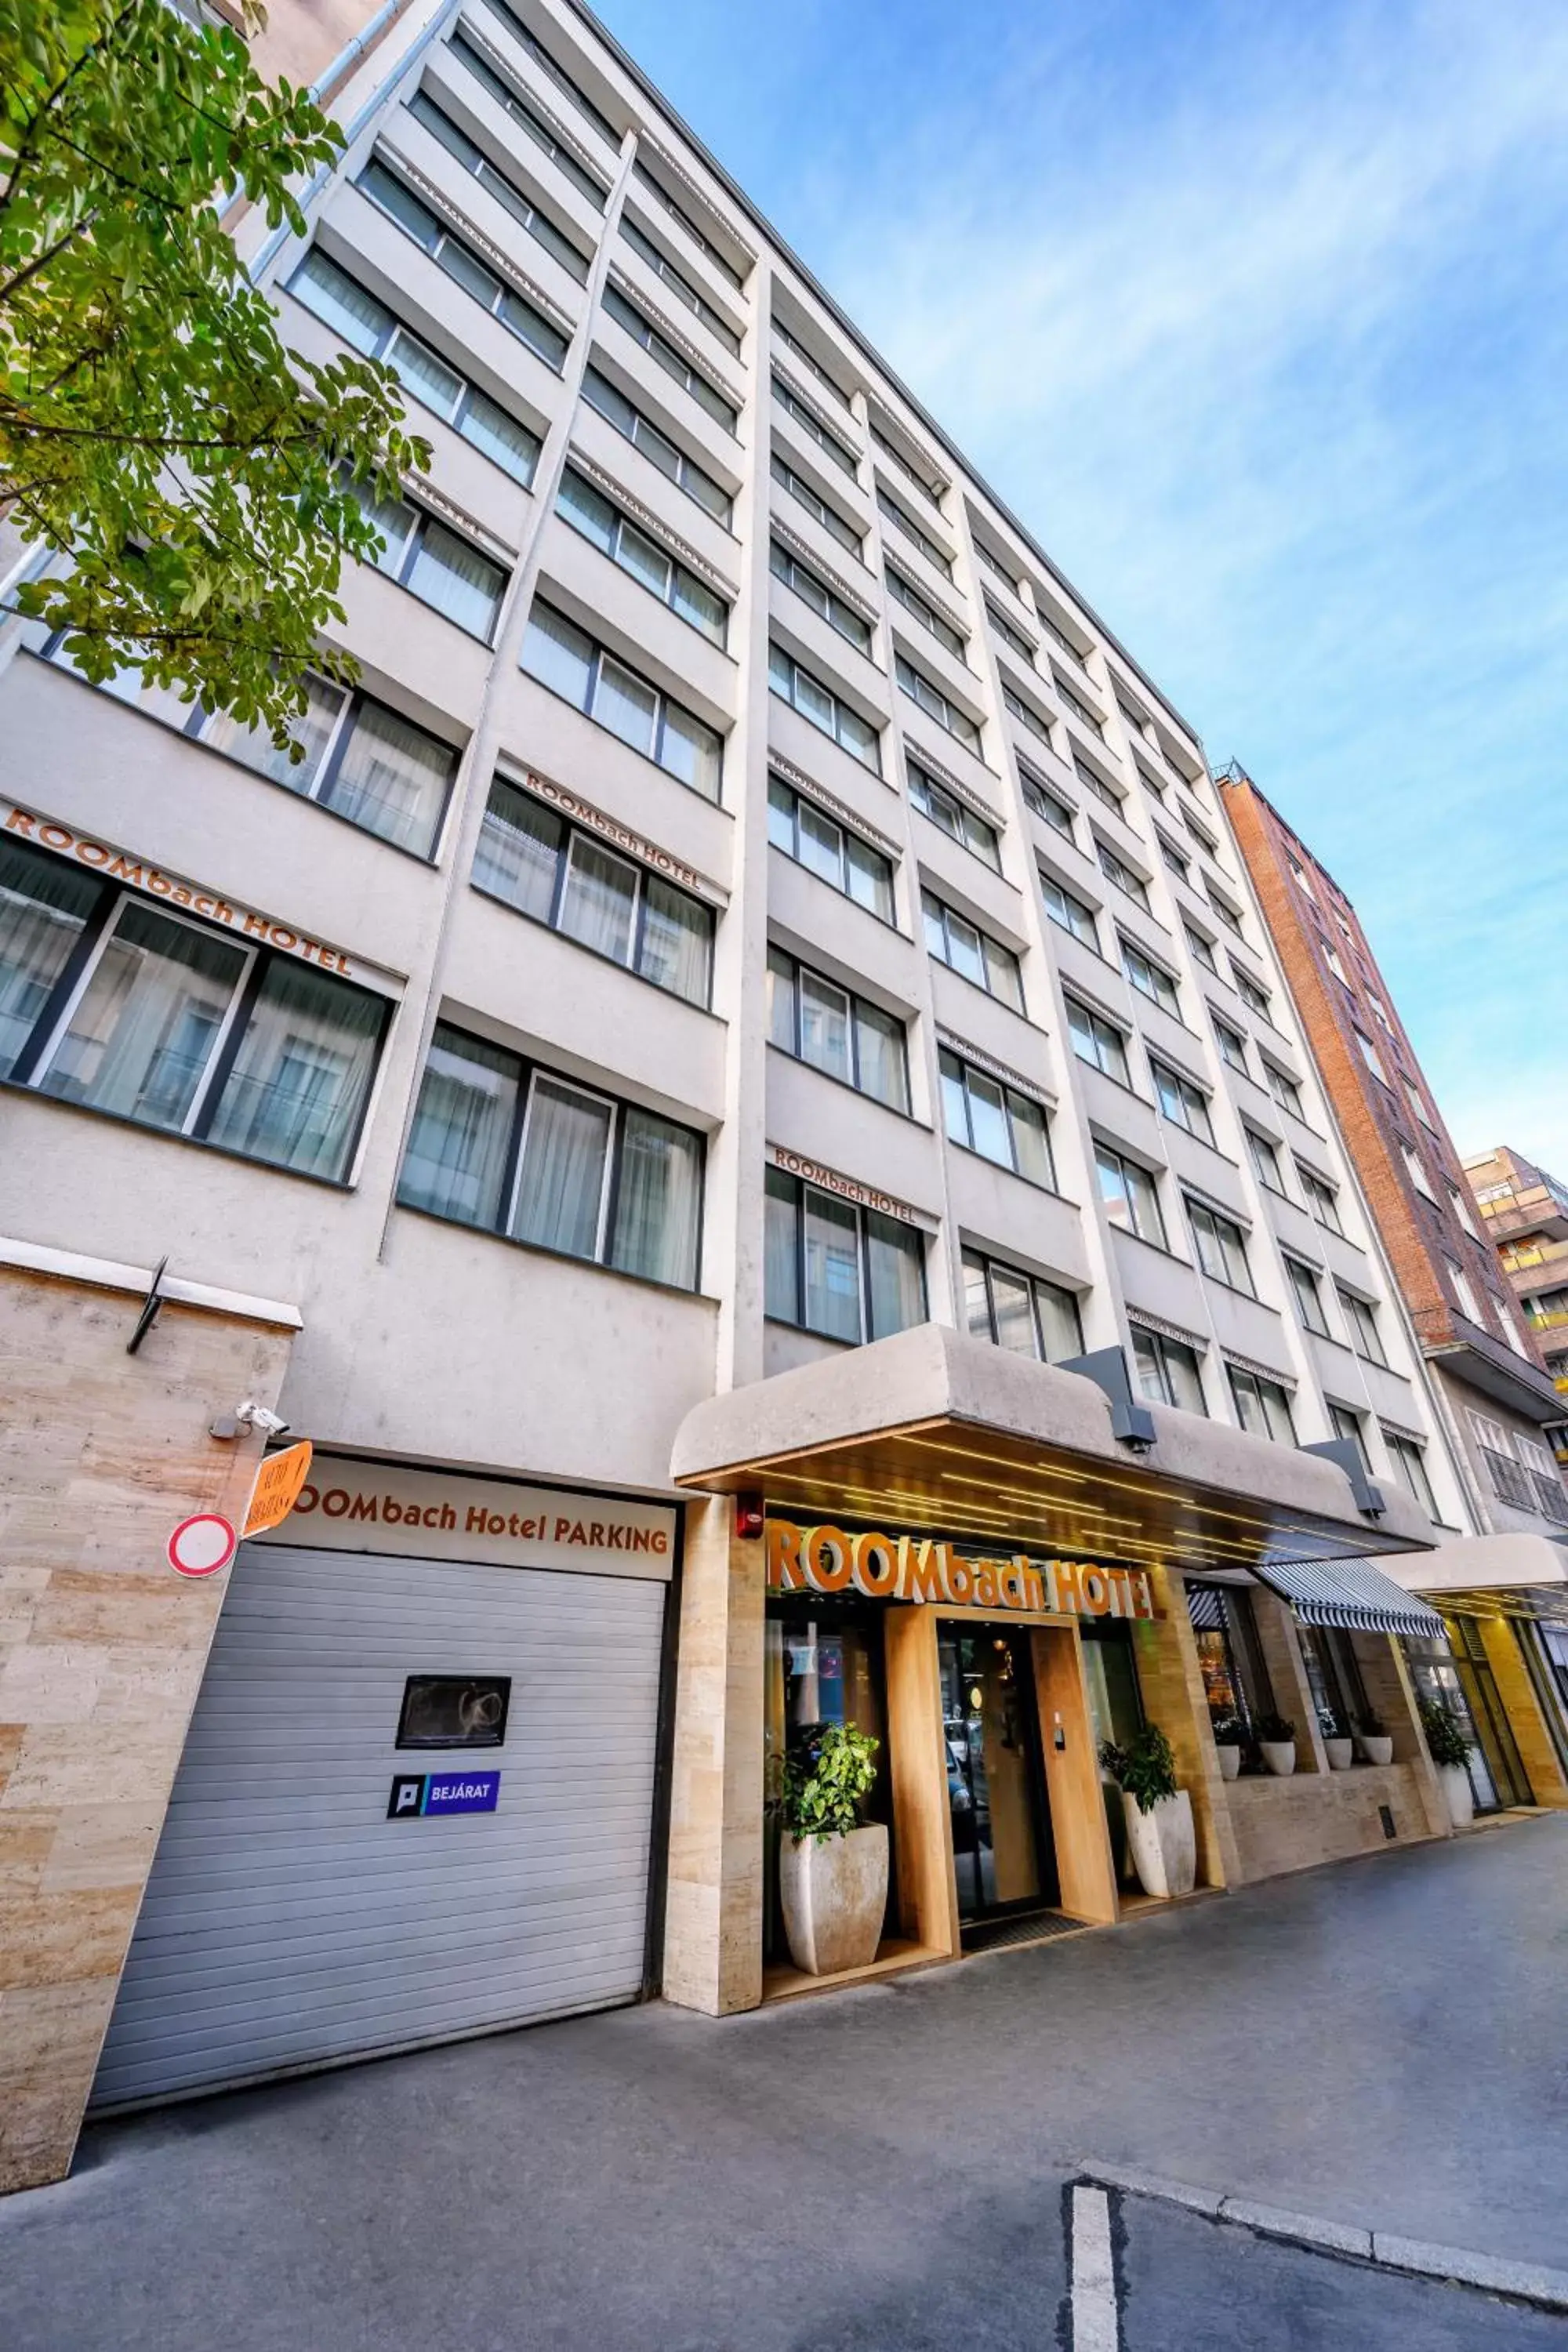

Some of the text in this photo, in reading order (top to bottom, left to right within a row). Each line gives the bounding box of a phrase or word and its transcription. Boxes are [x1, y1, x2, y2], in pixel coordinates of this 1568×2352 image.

[526, 770, 702, 891] ROOMbach HOTEL
[5, 808, 353, 976] ROOMbach HOTEL
[775, 1148, 916, 1224] ROOMbach HOTEL
[292, 1484, 457, 1530] OOMbach
[465, 1506, 546, 1541] Hotel
[554, 1517, 668, 1555] PARKING
[764, 1517, 1167, 1621] ROOMbach HOTEL
[431, 1783, 491, 1802] BEJÁRAT
